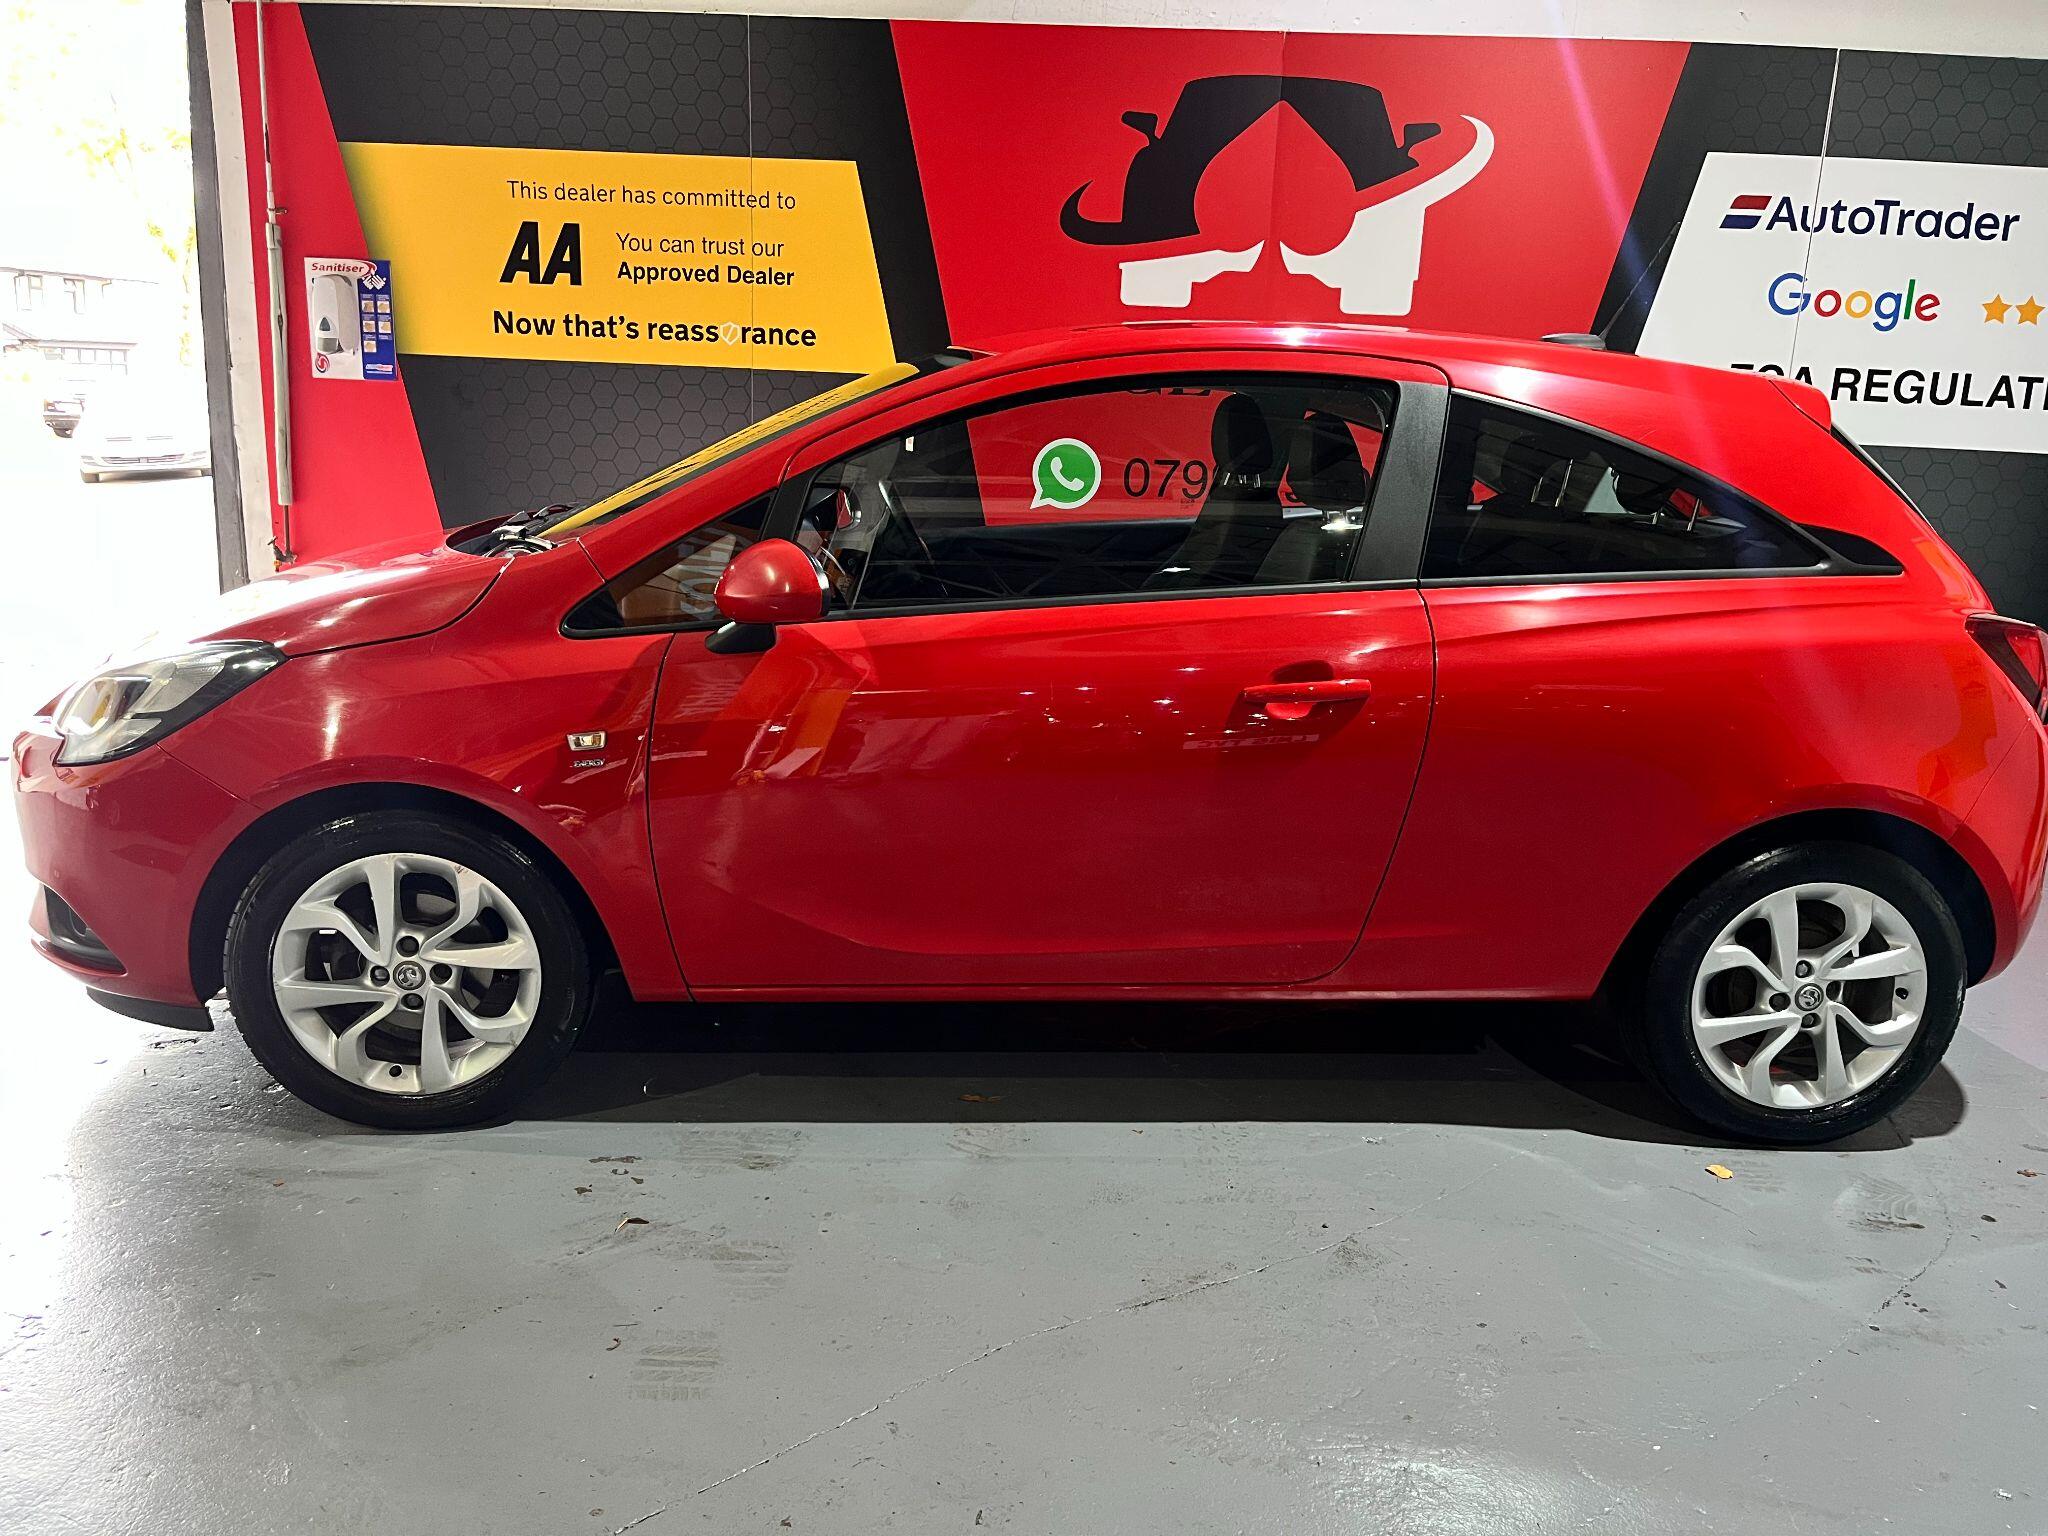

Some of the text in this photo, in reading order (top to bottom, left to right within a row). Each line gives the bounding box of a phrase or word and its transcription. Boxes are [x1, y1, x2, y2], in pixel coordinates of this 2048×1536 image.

[507, 180, 796, 210] This dealer has committed to
[1765, 196, 2020, 241] AutoTrader
[500, 221, 583, 286] AA
[616, 232, 785, 257] You can trust our
[312, 262, 365, 273] Sanitiser
[617, 262, 795, 285] Approved Dealer
[1768, 272, 1941, 332] Google
[493, 310, 555, 336] Now
[563, 313, 640, 340] that's
[1830, 367, 2048, 411] REGULAT
